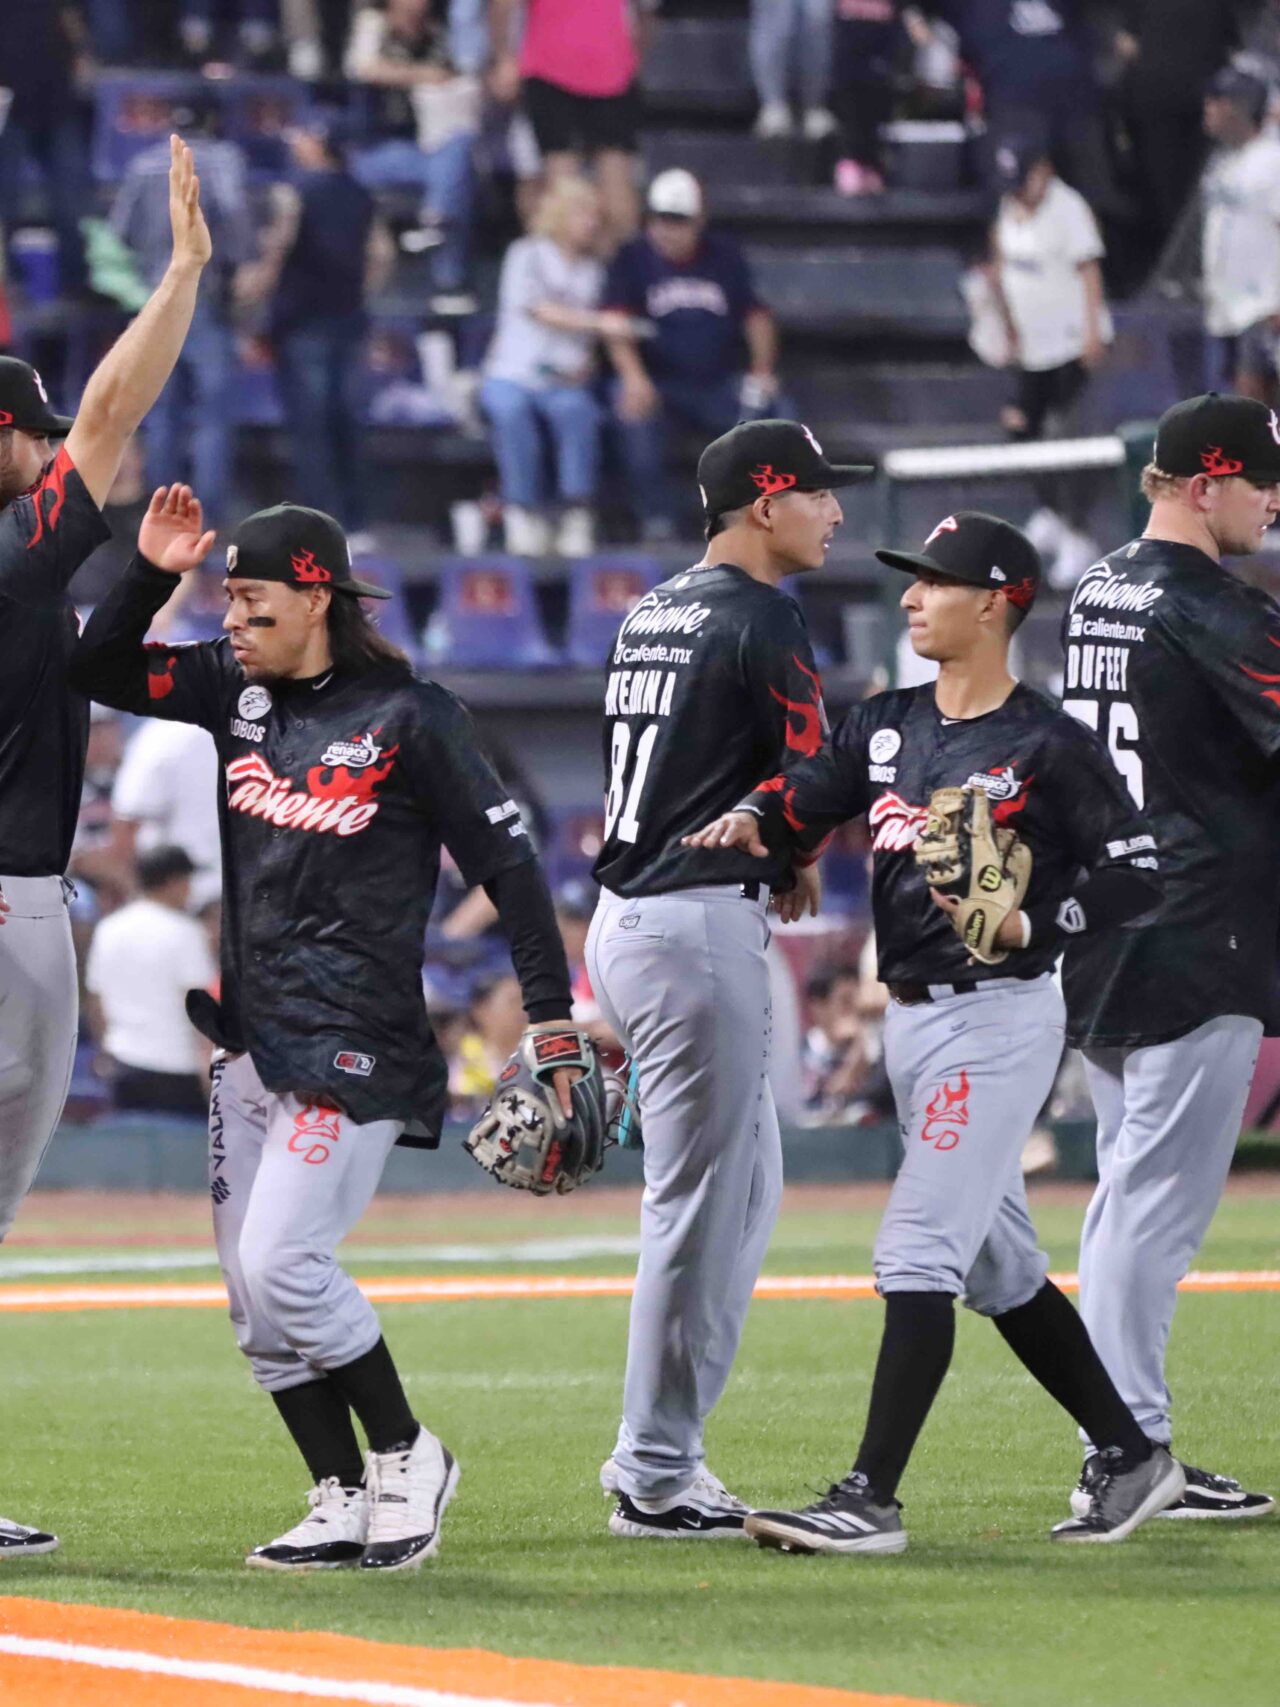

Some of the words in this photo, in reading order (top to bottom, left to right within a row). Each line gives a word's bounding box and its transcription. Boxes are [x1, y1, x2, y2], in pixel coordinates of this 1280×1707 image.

[617, 592, 712, 642] Caliente
[1070, 561, 1164, 615] Caliente
[225, 750, 379, 837] Caliente
[604, 722, 659, 844] 81
[1062, 699, 1144, 811] 6
